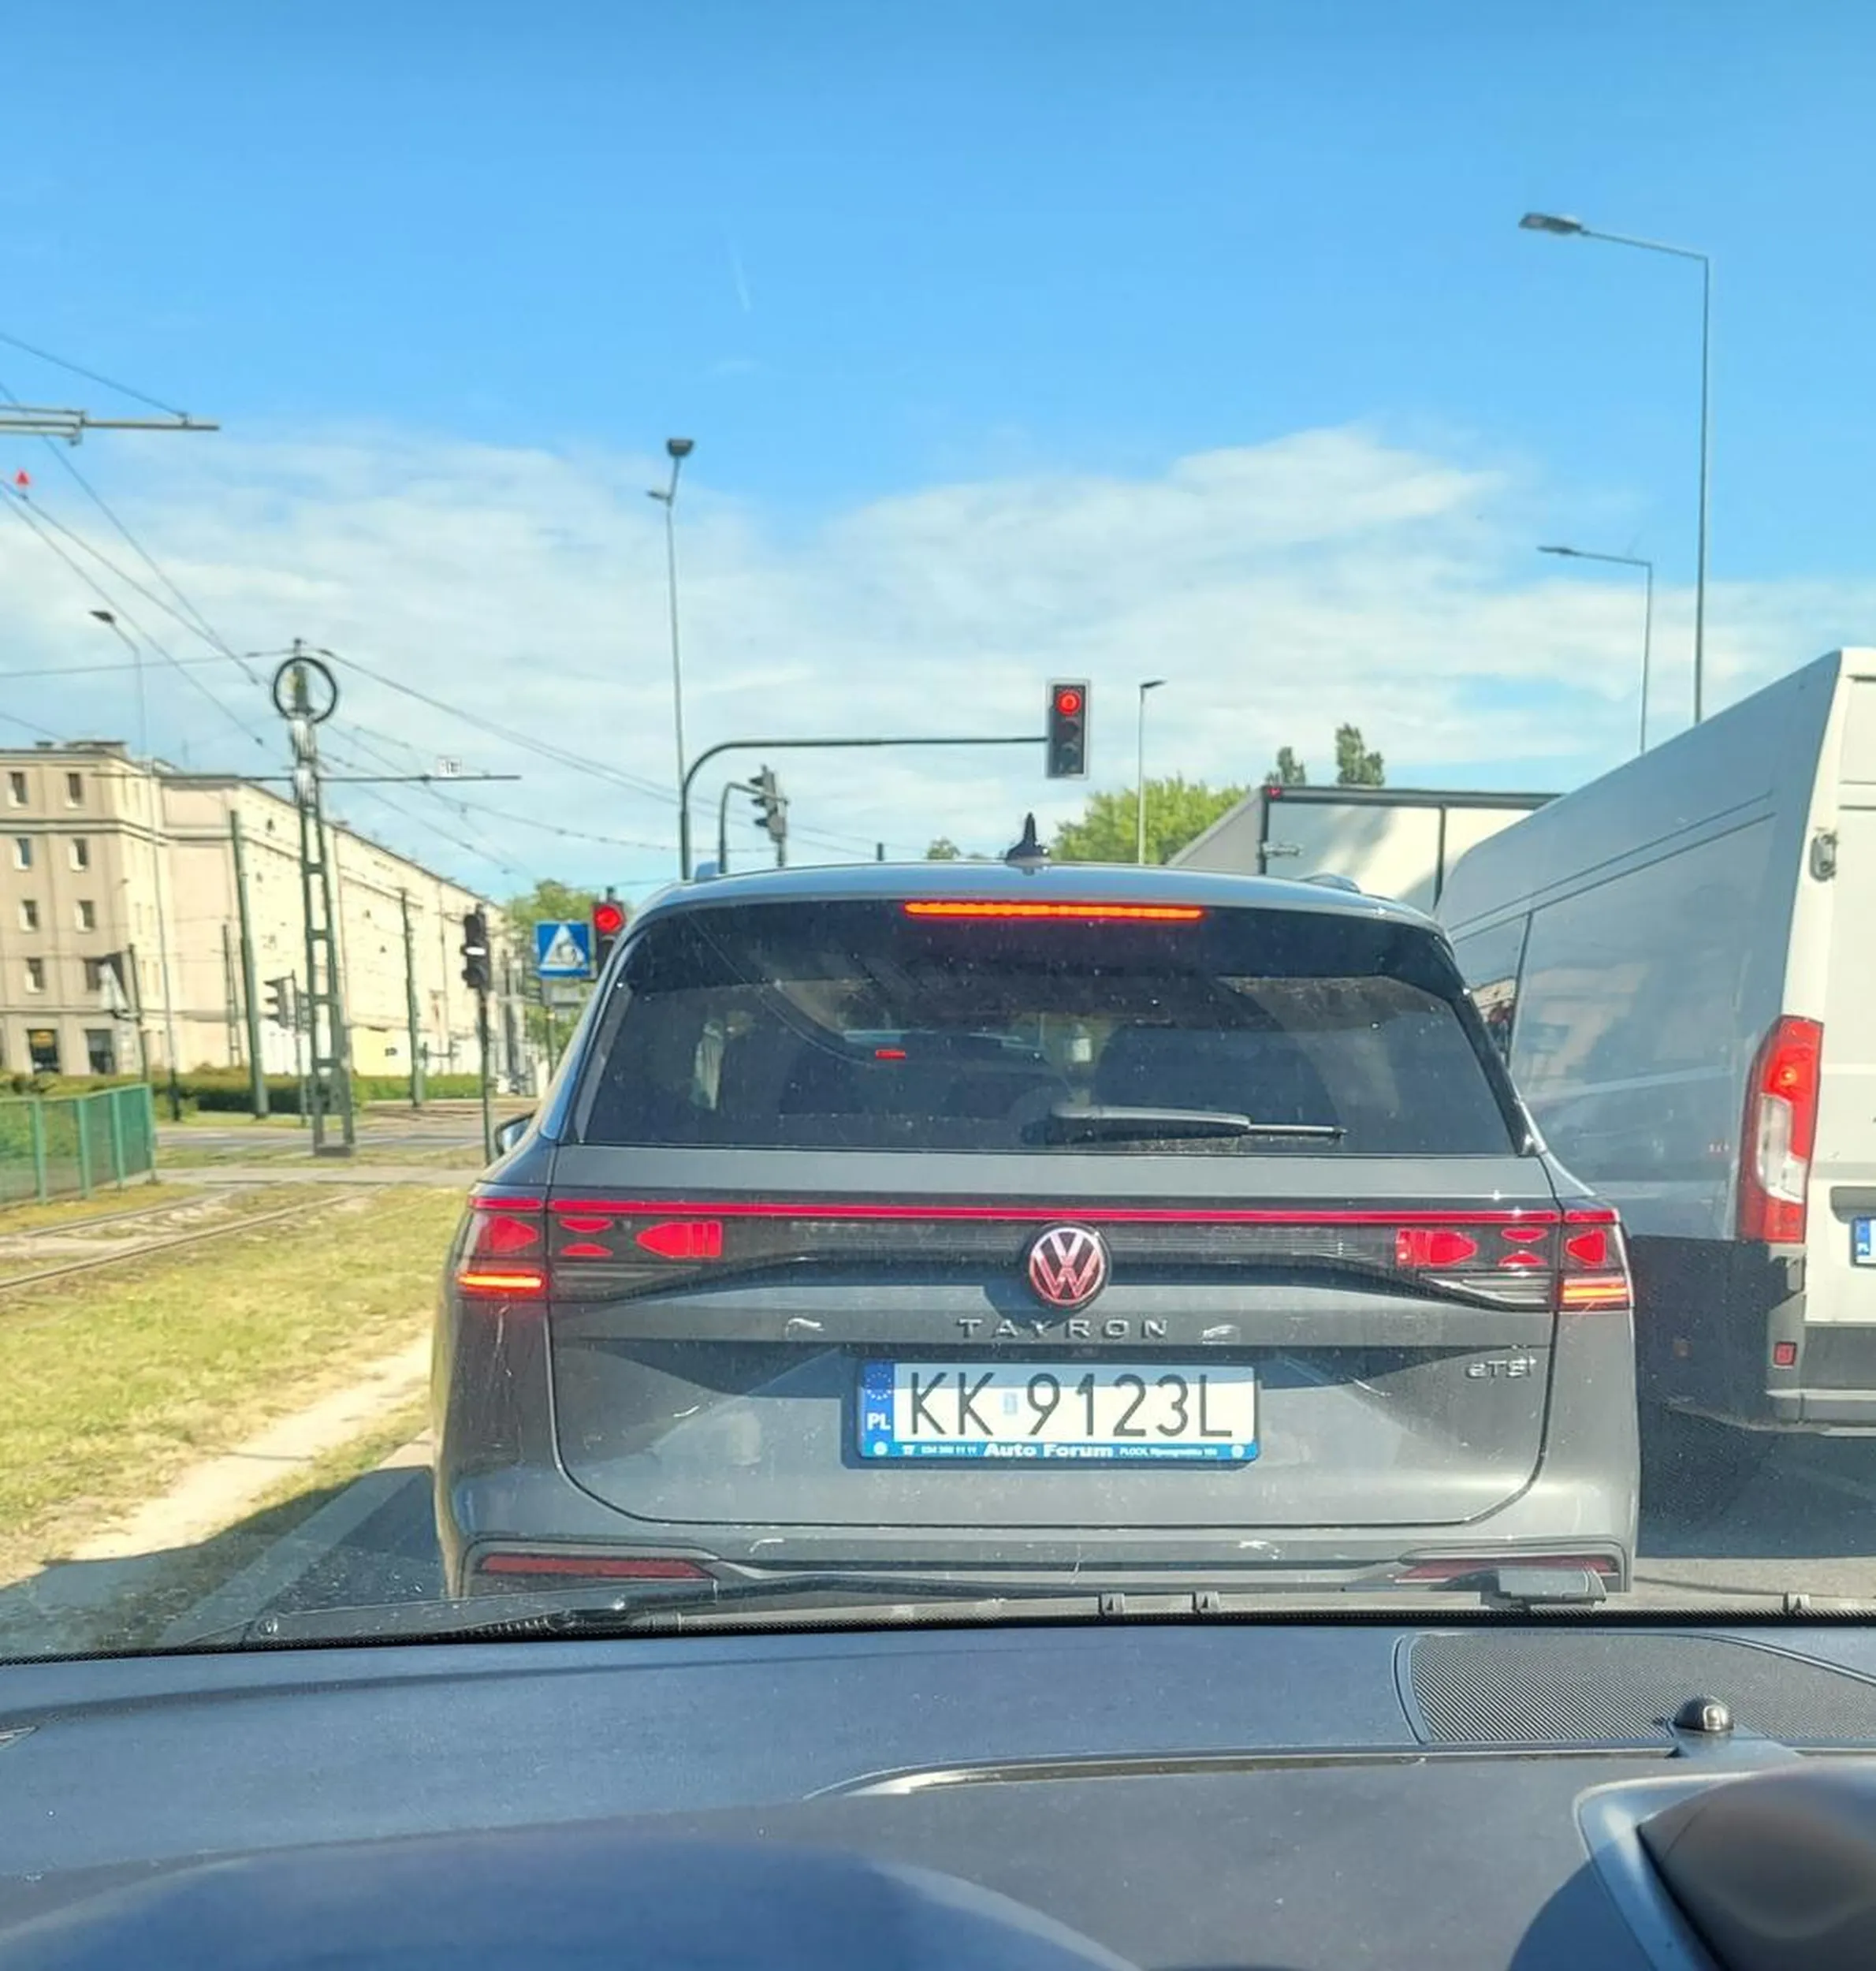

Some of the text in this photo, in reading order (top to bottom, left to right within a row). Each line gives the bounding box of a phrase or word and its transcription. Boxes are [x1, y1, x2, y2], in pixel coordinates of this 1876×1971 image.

[957, 1318, 1168, 1338] TAYRON
[911, 1372, 1233, 1436] KK 9123L
[867, 1412, 891, 1430] PL
[984, 1443, 1113, 1458] Auto Forum
